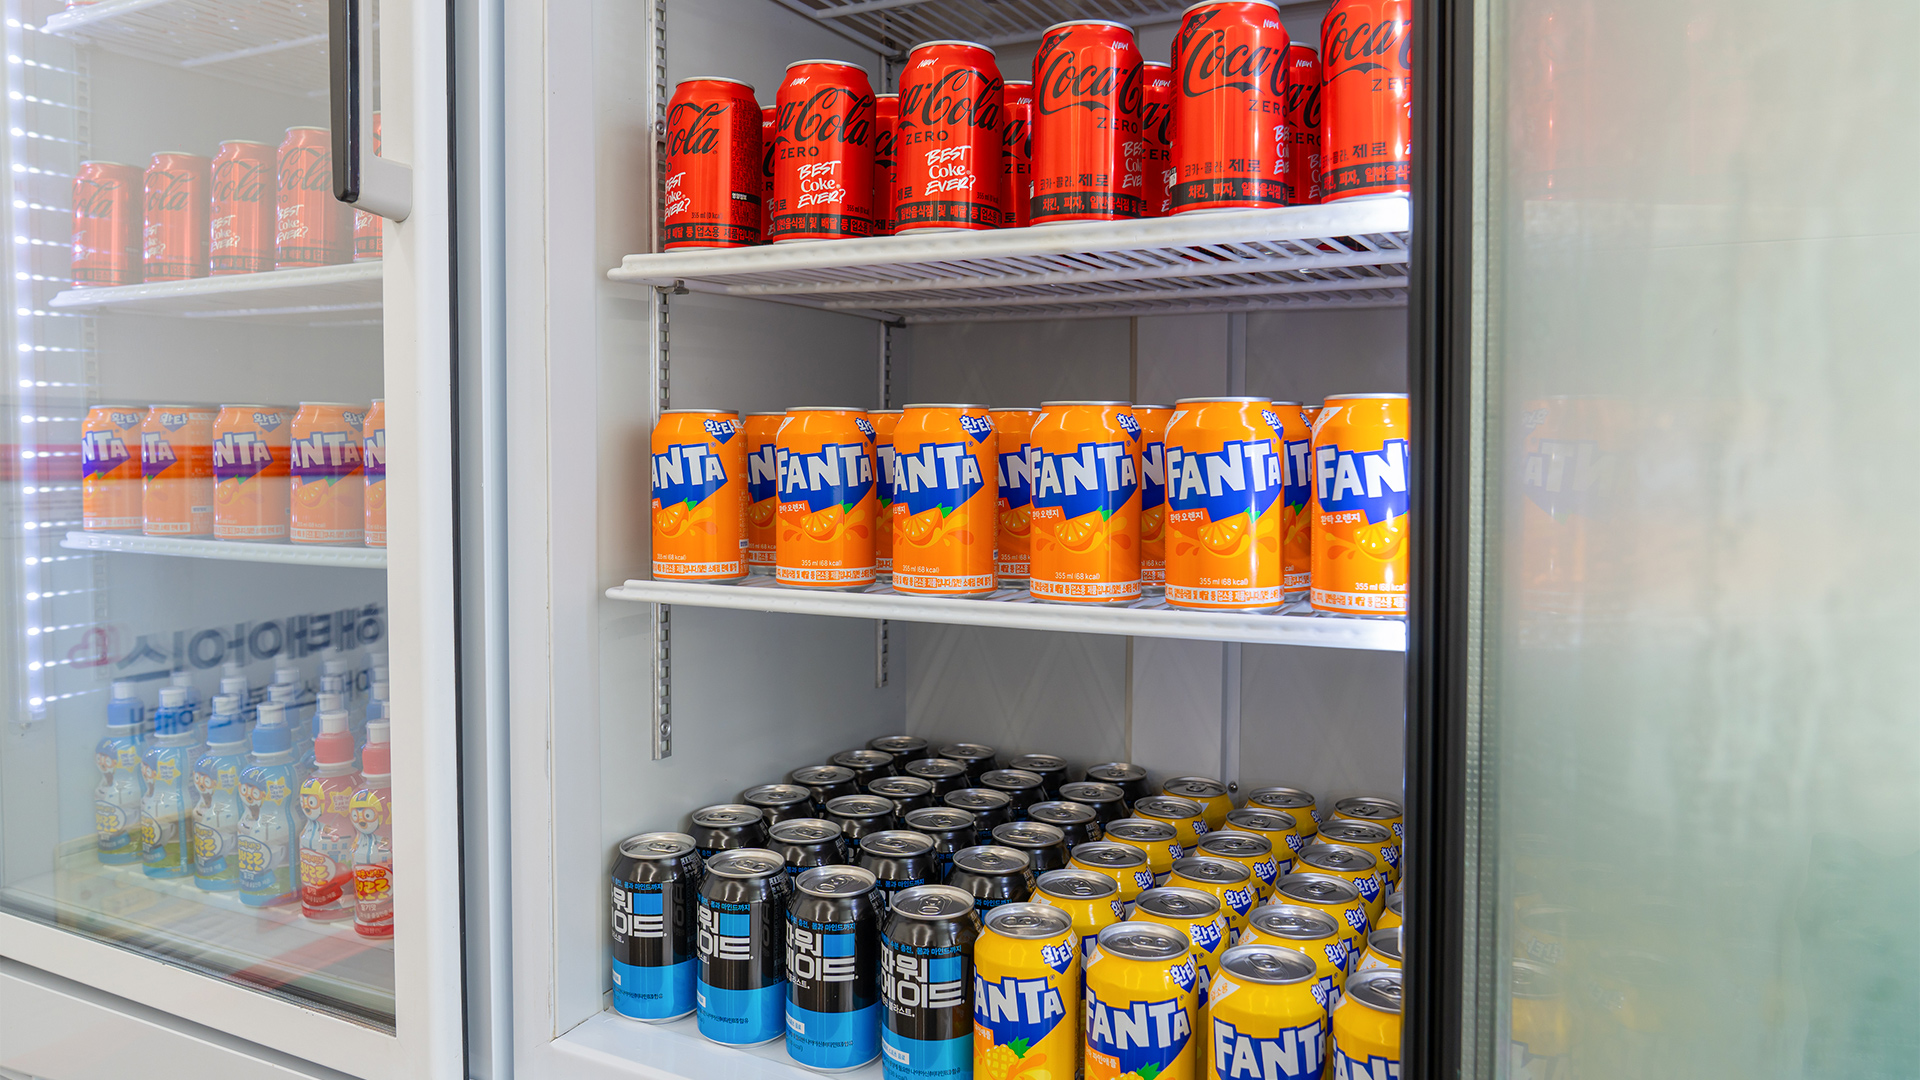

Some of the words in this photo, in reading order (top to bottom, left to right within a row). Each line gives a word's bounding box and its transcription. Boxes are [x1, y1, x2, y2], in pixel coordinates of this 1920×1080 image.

[1262, 19, 1280, 30] NEW
[1111, 41, 1129, 51] NEW
[917, 57, 939, 69] NEW
[1182, 29, 1290, 98] Coca-C
[790, 77, 811, 88] NEW
[1039, 51, 1143, 116] Coca-C
[1248, 99, 1288, 118] ZERO
[1097, 117, 1139, 134] ZERO
[905, 130, 949, 146] ZERO
[780, 146, 819, 160] ZERO
[925, 145, 971, 167] BEST
[1352, 142, 1387, 159] 제로
[797, 160, 841, 182] BEST
[1228, 159, 1261, 174] 제로
[1365, 164, 1409, 184] 일반음식
[925, 174, 976, 196] EVER?
[1078, 174, 1109, 188] 제로
[797, 189, 846, 210] EVER?
[938, 204, 947, 217] 및
[950, 206, 967, 218] 배달
[970, 207, 979, 220] 등
[686, 226, 694, 238] 등
[696, 226, 720, 238] 업소용
[809, 216, 818, 230] 및
[821, 217, 838, 231] 배달
[841, 219, 850, 231] 등
[706, 419, 736, 436] 환타
[961, 415, 990, 433] 환타
[652, 446, 725, 492] ANTA
[777, 446, 873, 494] FANTA
[893, 445, 982, 495] ANTA
[1031, 445, 1137, 498] FANTA
[1166, 443, 1282, 500] FANTA
[1317, 443, 1408, 501] FAN
[787, 502, 806, 512] 오렌지
[1040, 509, 1060, 519] 오렌지
[1181, 510, 1204, 522] 오렌지
[1320, 514, 1334, 525] 환타
[1335, 512, 1362, 524] 오렌지
[801, 559, 812, 567] 355
[1055, 571, 1066, 579] 355
[1074, 572, 1085, 580] (68
[1085, 572, 1101, 580] kcal)
[1199, 577, 1211, 585] 355
[1212, 578, 1220, 586] ml
[1221, 578, 1232, 586] (68
[1232, 578, 1249, 586] kcal)
[1355, 582, 1369, 591] 355
[1369, 583, 1378, 591] ml
[1375, 596, 1392, 609] 업소용
[1253, 859, 1277, 882] 환타
[634, 883, 664, 892] 마인드까지
[1354, 874, 1380, 896] 환타
[611, 885, 633, 916] 워
[721, 902, 751, 912] 마인드까지
[1225, 887, 1252, 909] 환타
[611, 907, 664, 938] 이드
[697, 900, 719, 934] 워
[824, 922, 856, 933] 마인드까지
[1191, 922, 1221, 946] 환타
[697, 929, 750, 960] 이드
[916, 948, 930, 957] 몸과
[931, 944, 962, 957] 마인드까지
[881, 942, 928, 983] 파워
[1042, 940, 1073, 968] 환타
[1170, 957, 1196, 987] 환타
[1211, 982, 1228, 1001] 업소용
[974, 977, 1064, 1025] ANTA
[1086, 986, 1191, 1050] FANTA
[1092, 1052, 1117, 1069] 파인애플
